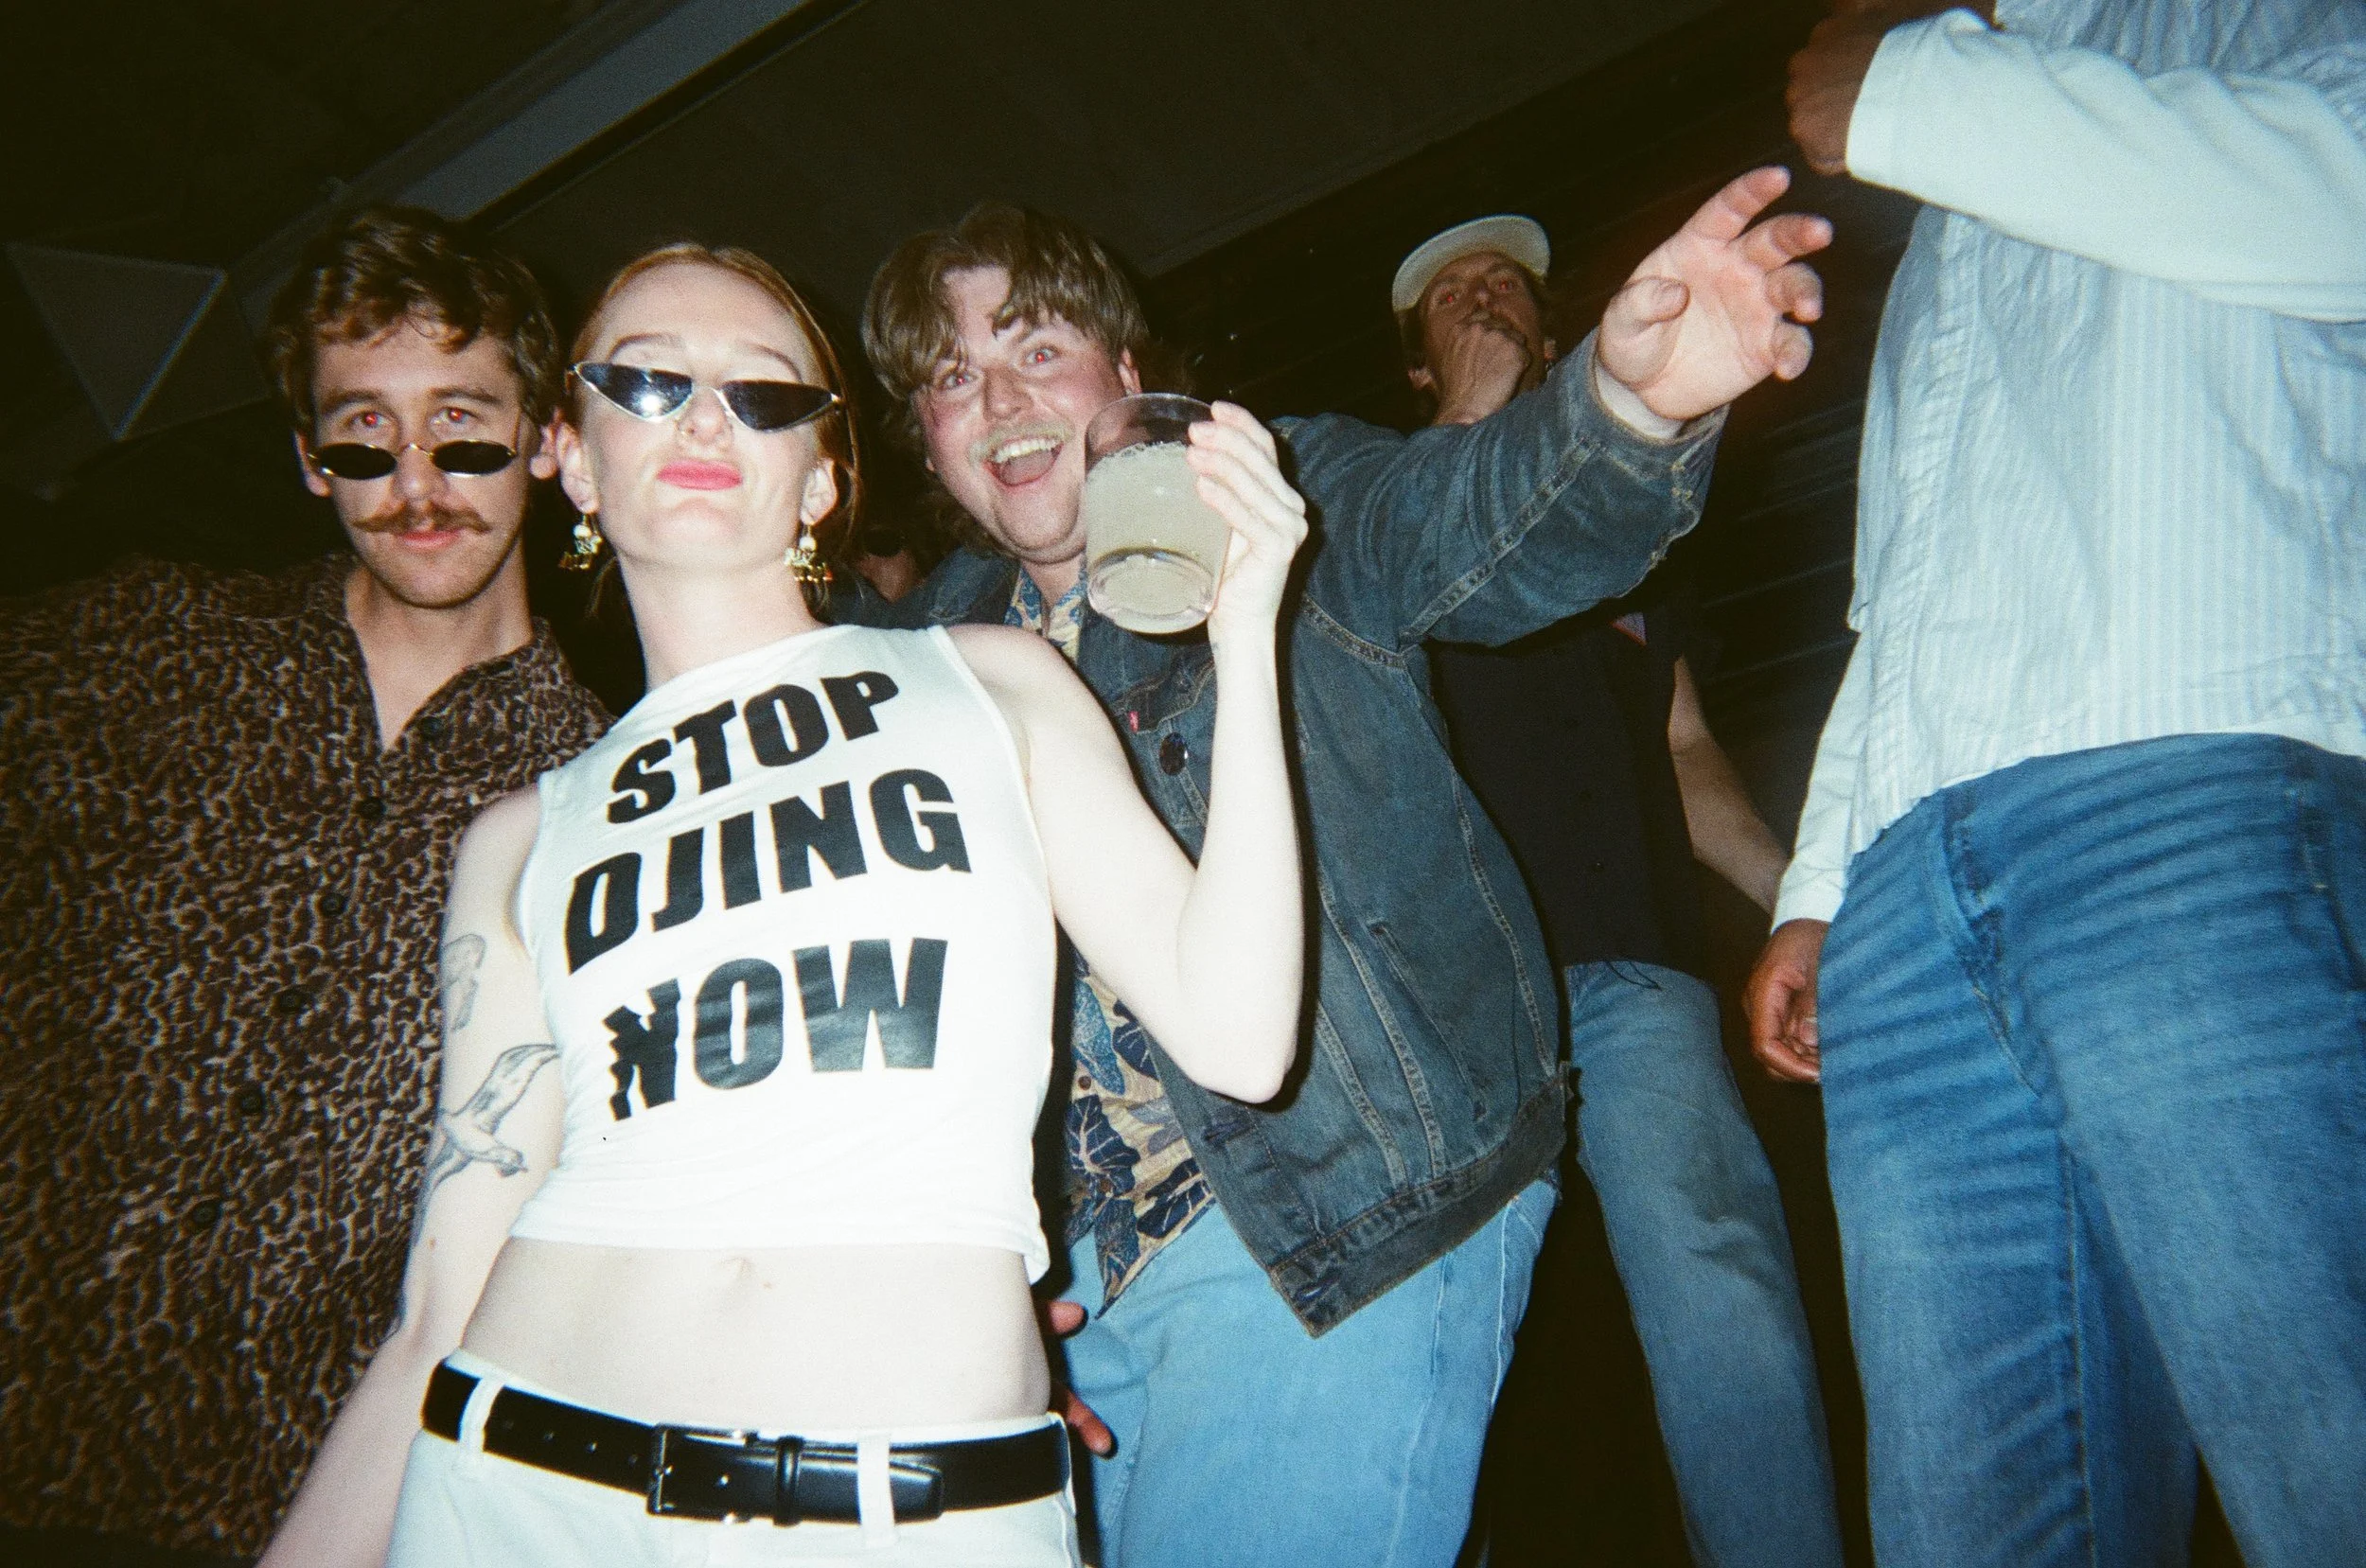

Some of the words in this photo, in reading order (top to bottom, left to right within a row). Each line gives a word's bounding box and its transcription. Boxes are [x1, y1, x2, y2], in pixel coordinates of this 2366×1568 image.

[606, 670, 899, 824] STOP
[565, 768, 972, 976] DJING
[602, 938, 948, 1121] NOW
